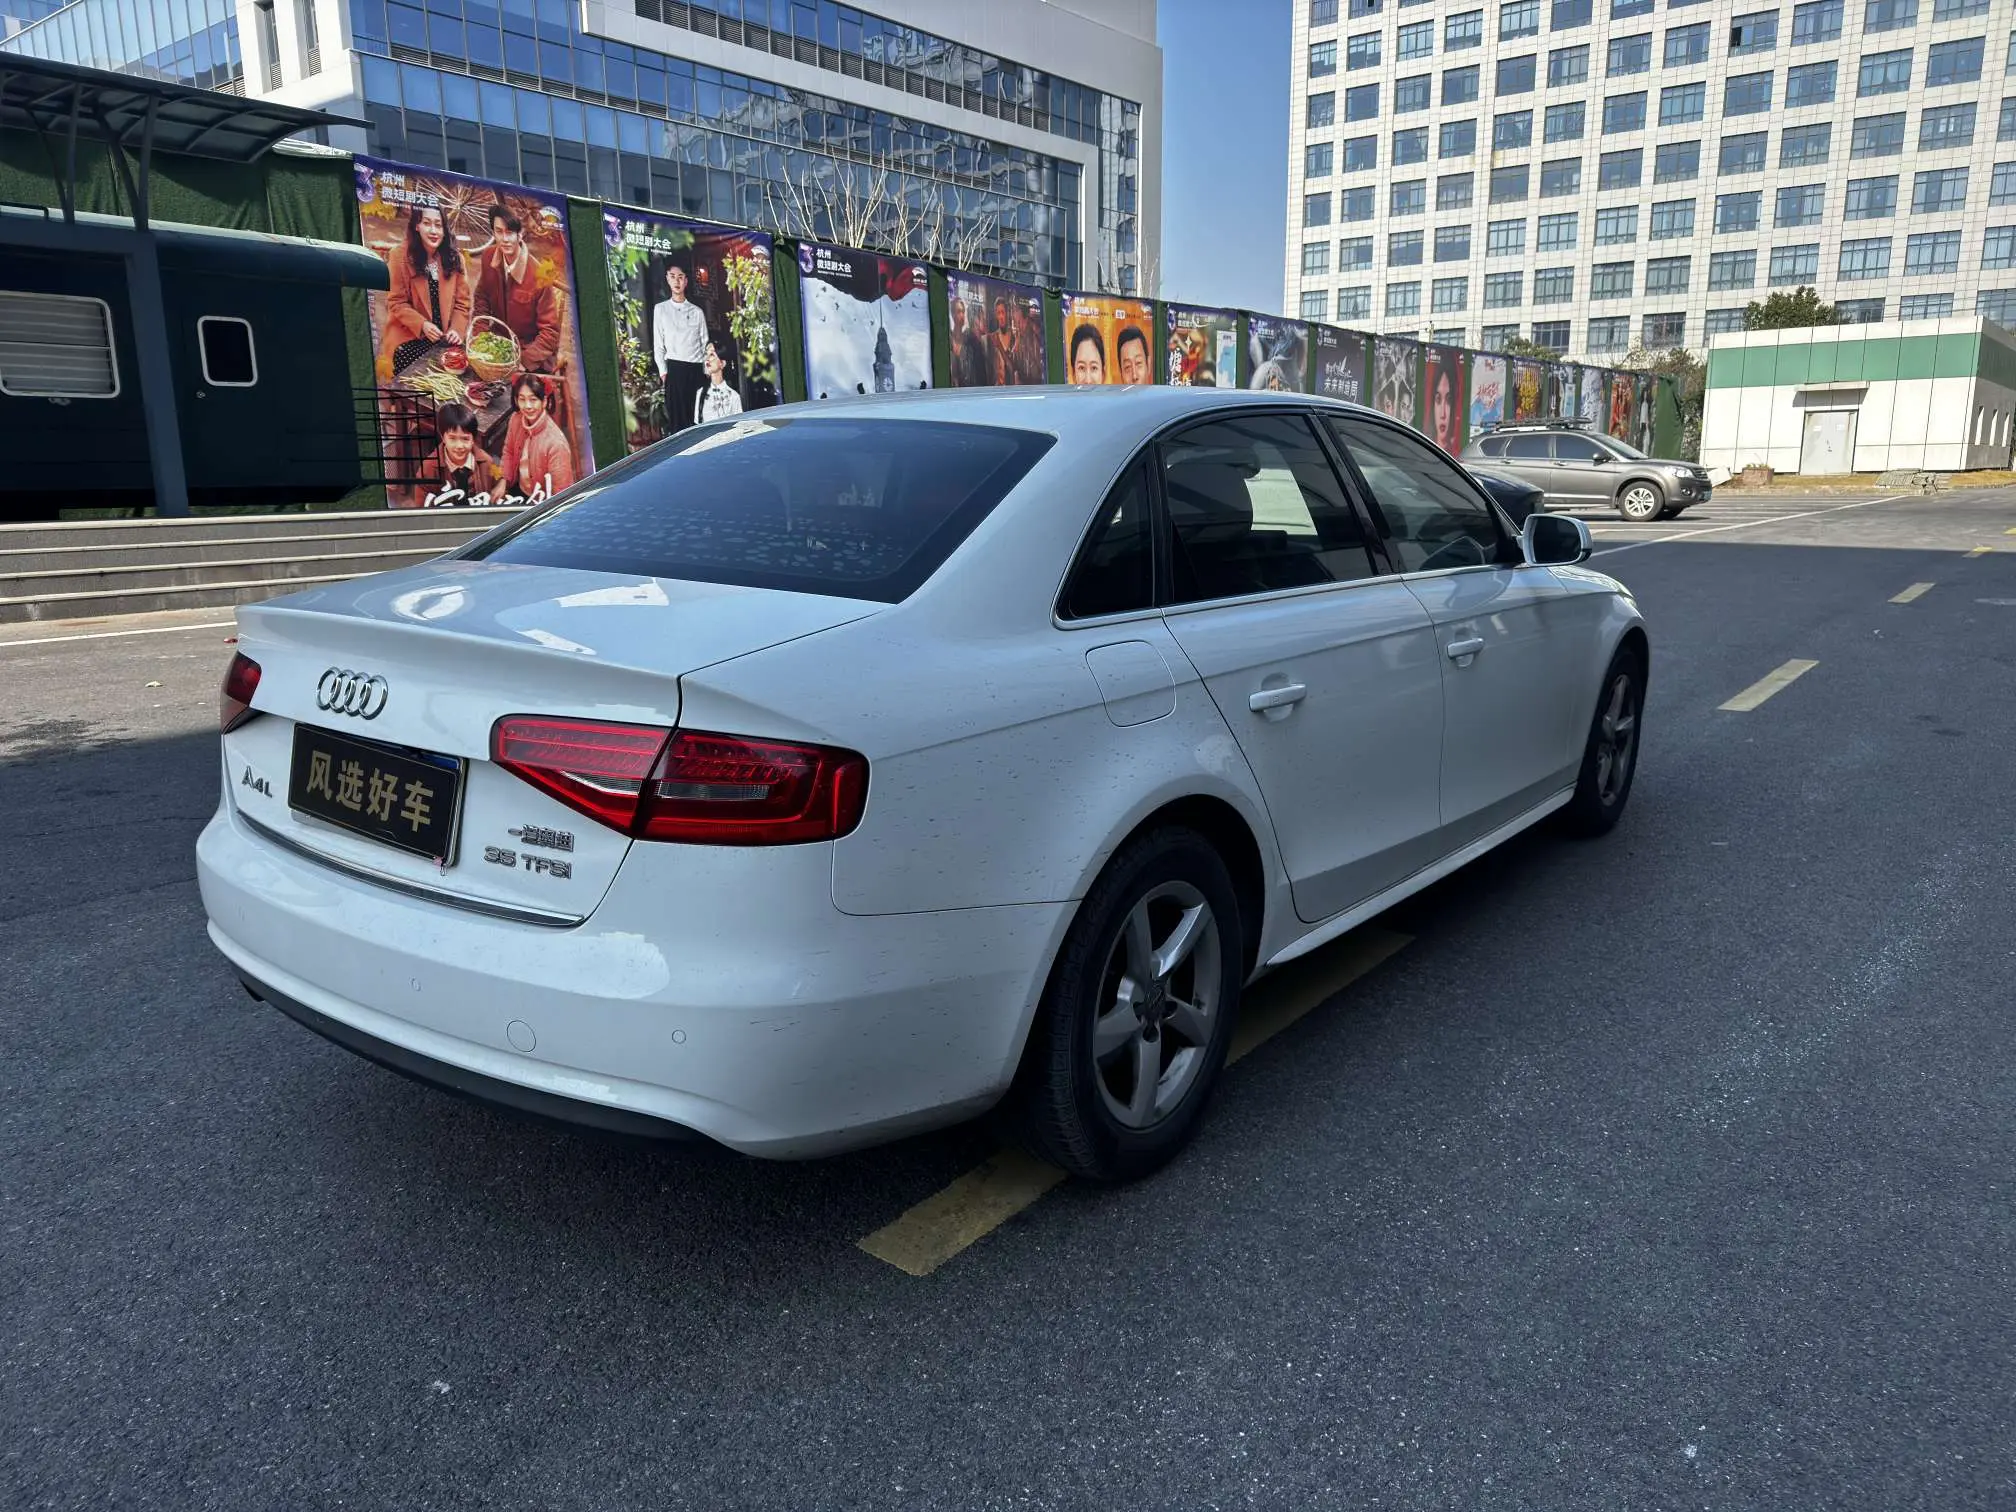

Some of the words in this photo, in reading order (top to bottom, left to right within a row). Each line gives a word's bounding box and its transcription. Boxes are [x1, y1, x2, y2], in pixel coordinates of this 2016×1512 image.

[382, 171, 405, 187] 杭州
[382, 186, 440, 207] 微短剧大会
[625, 220, 645, 233] 杭州
[625, 233, 672, 250] 微短剧大会
[241, 765, 273, 798] A4L
[306, 750, 434, 833] 风选好车
[484, 845, 516, 867] 35
[521, 853, 572, 880] TFSI
